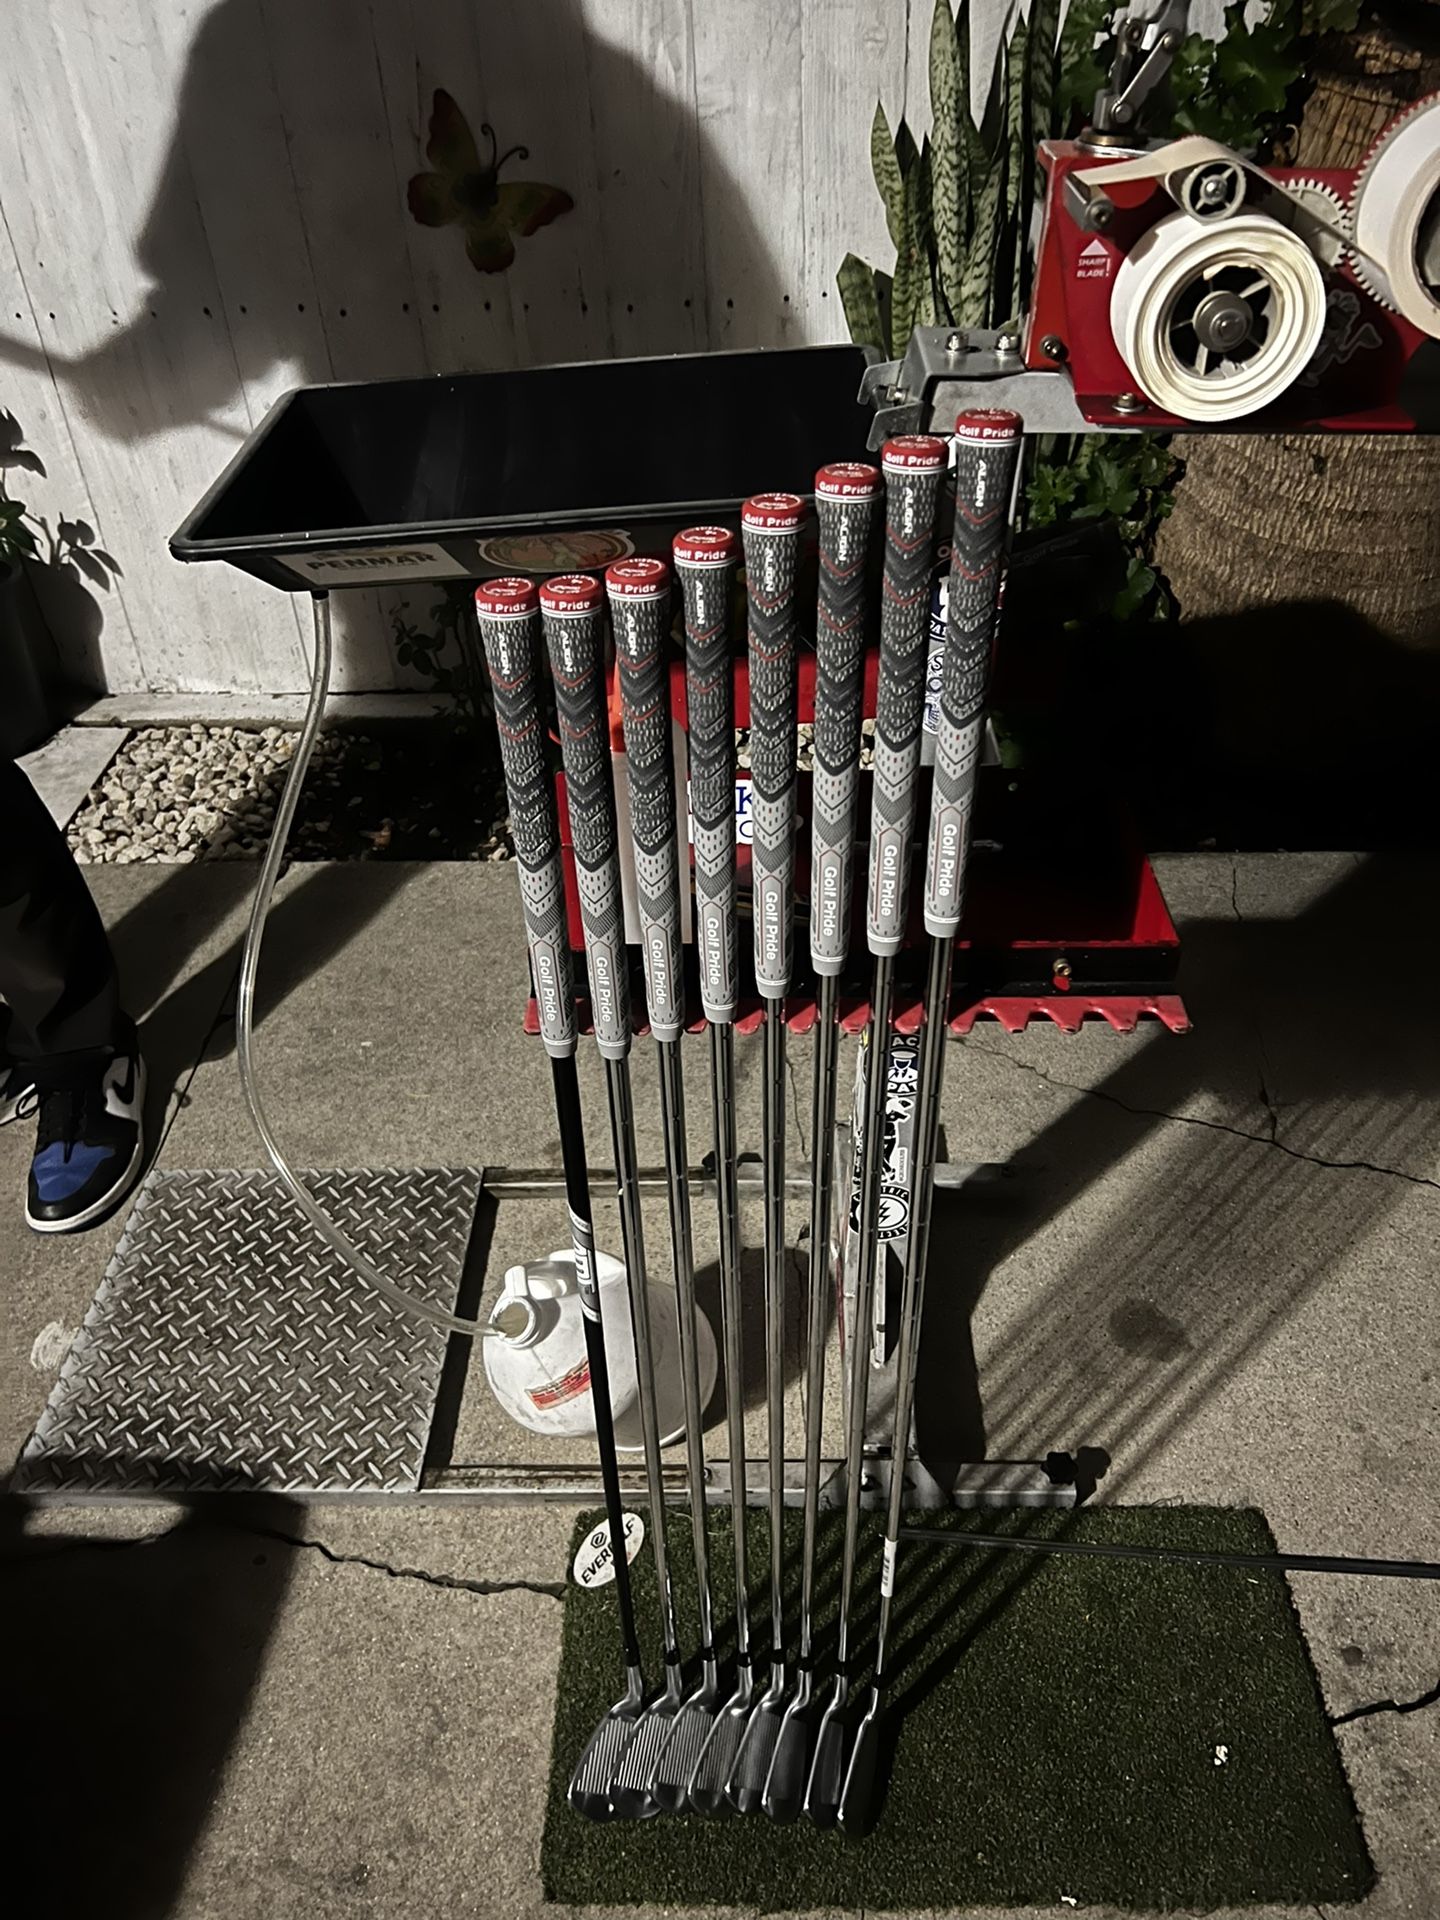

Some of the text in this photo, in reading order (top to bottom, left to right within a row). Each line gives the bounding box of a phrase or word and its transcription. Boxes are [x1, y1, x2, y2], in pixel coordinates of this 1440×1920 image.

[1078, 258, 1105, 266] SHARP
[959, 424, 1015, 438] Golf Pride
[885, 452, 940, 466] Golf Pride
[819, 481, 873, 494] Golf Pride
[745, 512, 798, 527] Golf Pride
[306, 554, 436, 570] PENMAR
[694, 550, 726, 560] Pride
[625, 584, 656, 594] Pride
[495, 603, 527, 612] Pride
[559, 601, 590, 610] Pride
[938, 823, 958, 897] Golf Pride
[881, 845, 898, 917] Golf Pride
[823, 866, 837, 937] Golf Pride
[765, 891, 778, 961] Golf Pride
[706, 917, 720, 985] Golf Pride
[652, 939, 667, 1005] Golf Pride
[539, 957, 556, 1022] Golf Pride
[596, 957, 613, 1022] Golf Pride
[581, 1519, 635, 1584] EVERF
